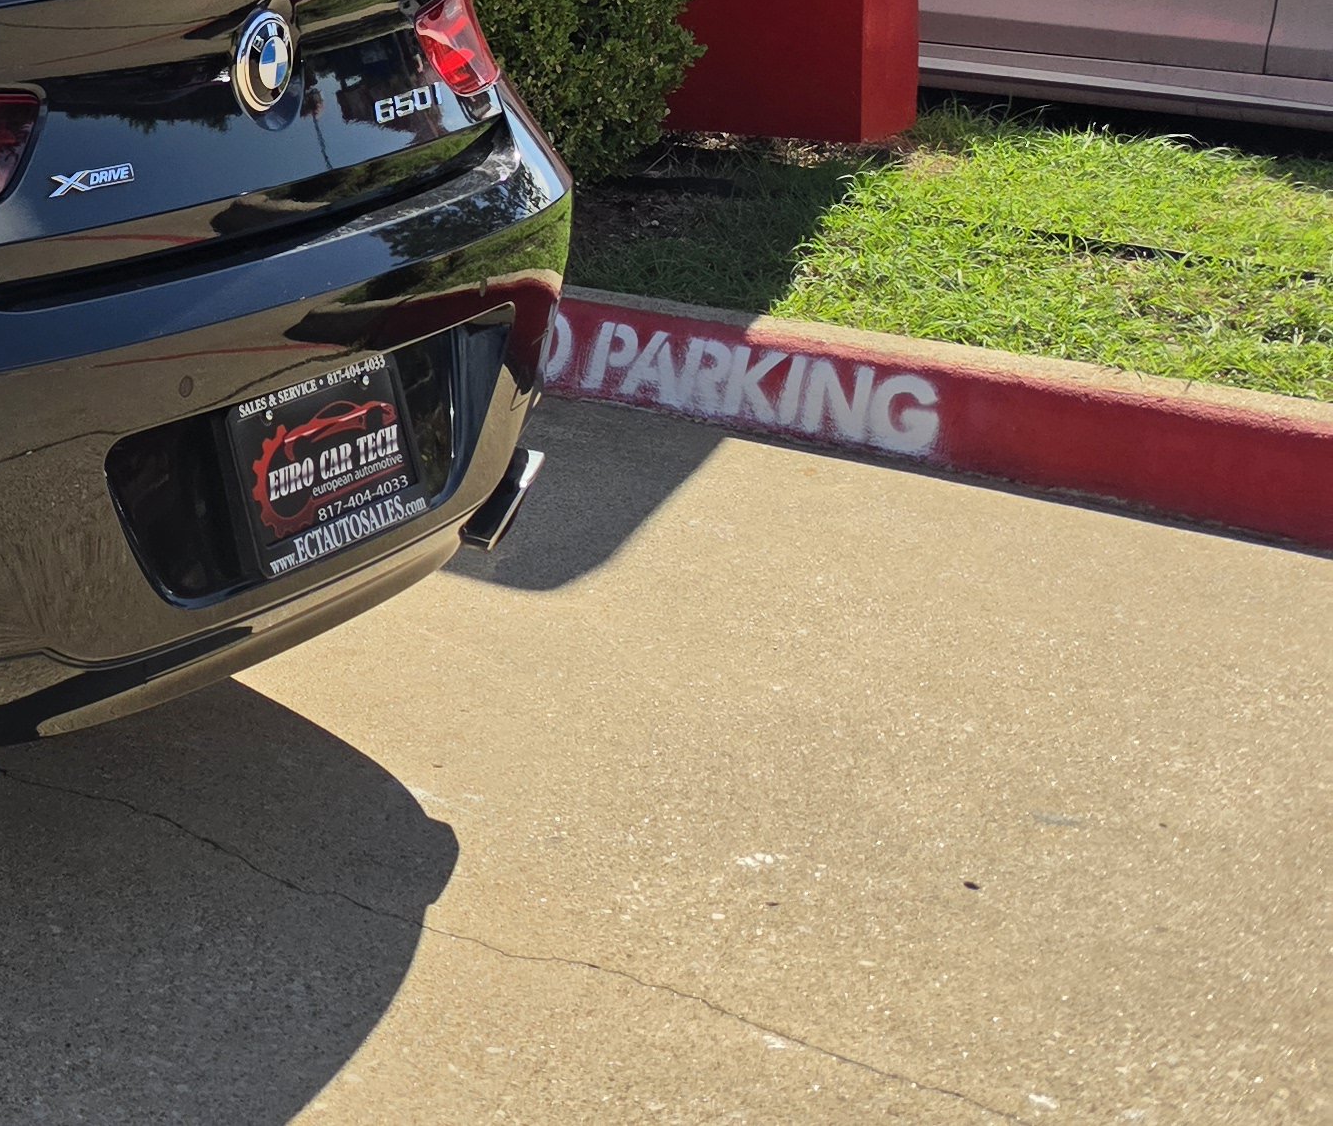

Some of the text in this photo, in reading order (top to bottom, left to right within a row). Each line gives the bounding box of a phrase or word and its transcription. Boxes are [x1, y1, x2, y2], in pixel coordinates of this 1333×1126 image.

[239, 355, 385, 418] SALES & SERVICE 817-404-4033
[580, 321, 939, 456] PARKING
[268, 424, 399, 501] EURO CAR TECH
[313, 454, 403, 496] european automotive
[318, 475, 408, 521] 817-404-4033
[270, 495, 426, 573] www.ECTAUTOSALES.com
